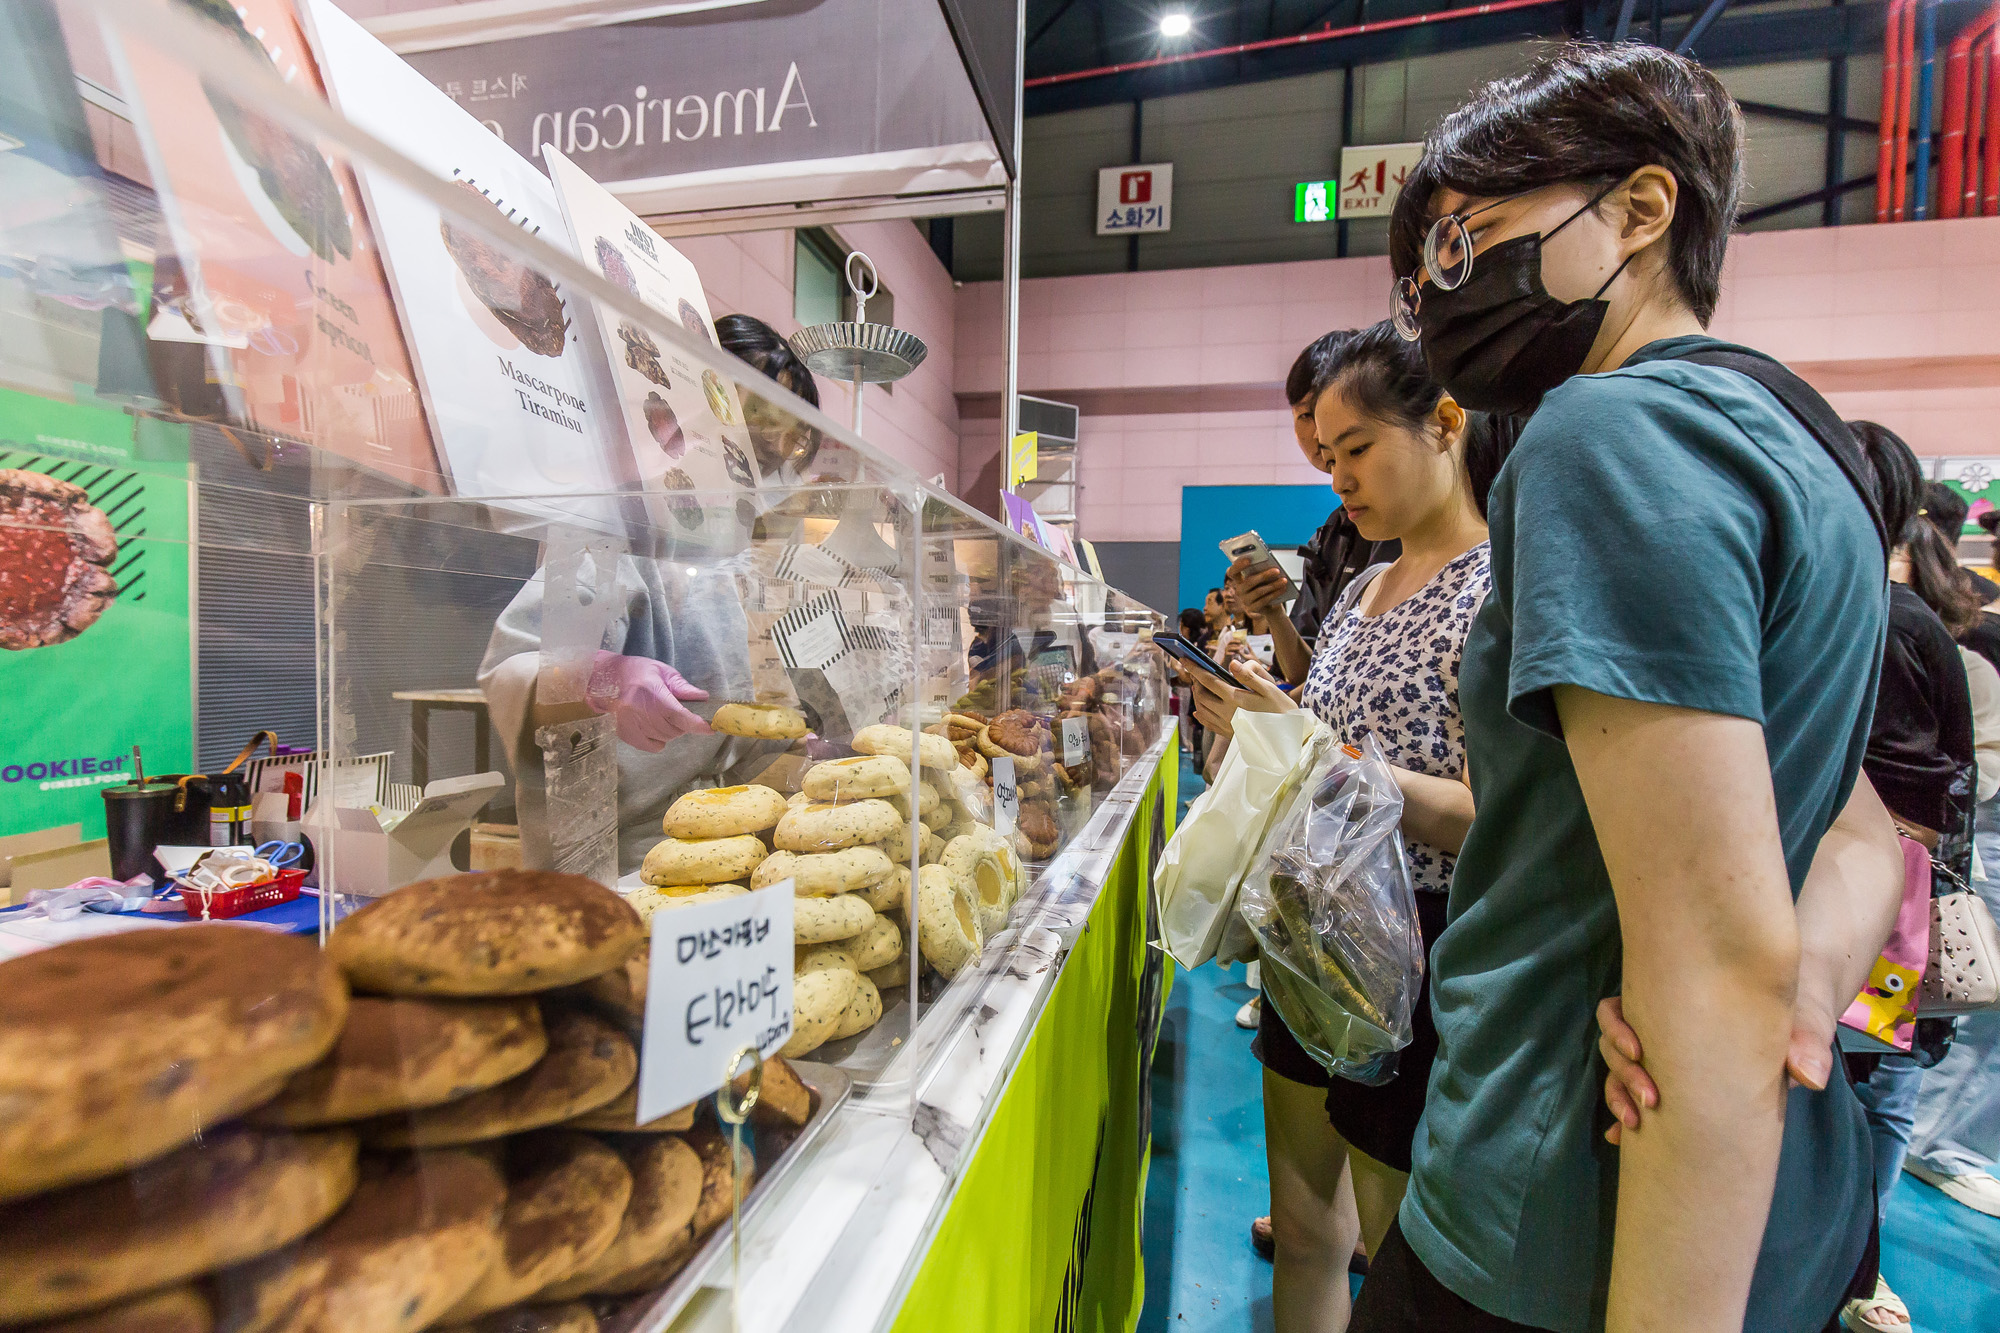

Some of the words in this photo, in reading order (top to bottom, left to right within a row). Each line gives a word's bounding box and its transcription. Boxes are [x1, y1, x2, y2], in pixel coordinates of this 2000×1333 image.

[1105, 205, 1163, 229] 소화기
[1343, 197, 1379, 209] EXIT
[629, 220, 656, 252] JUST
[496, 355, 587, 413] Mascarpone
[514, 388, 583, 434] Tiramisu
